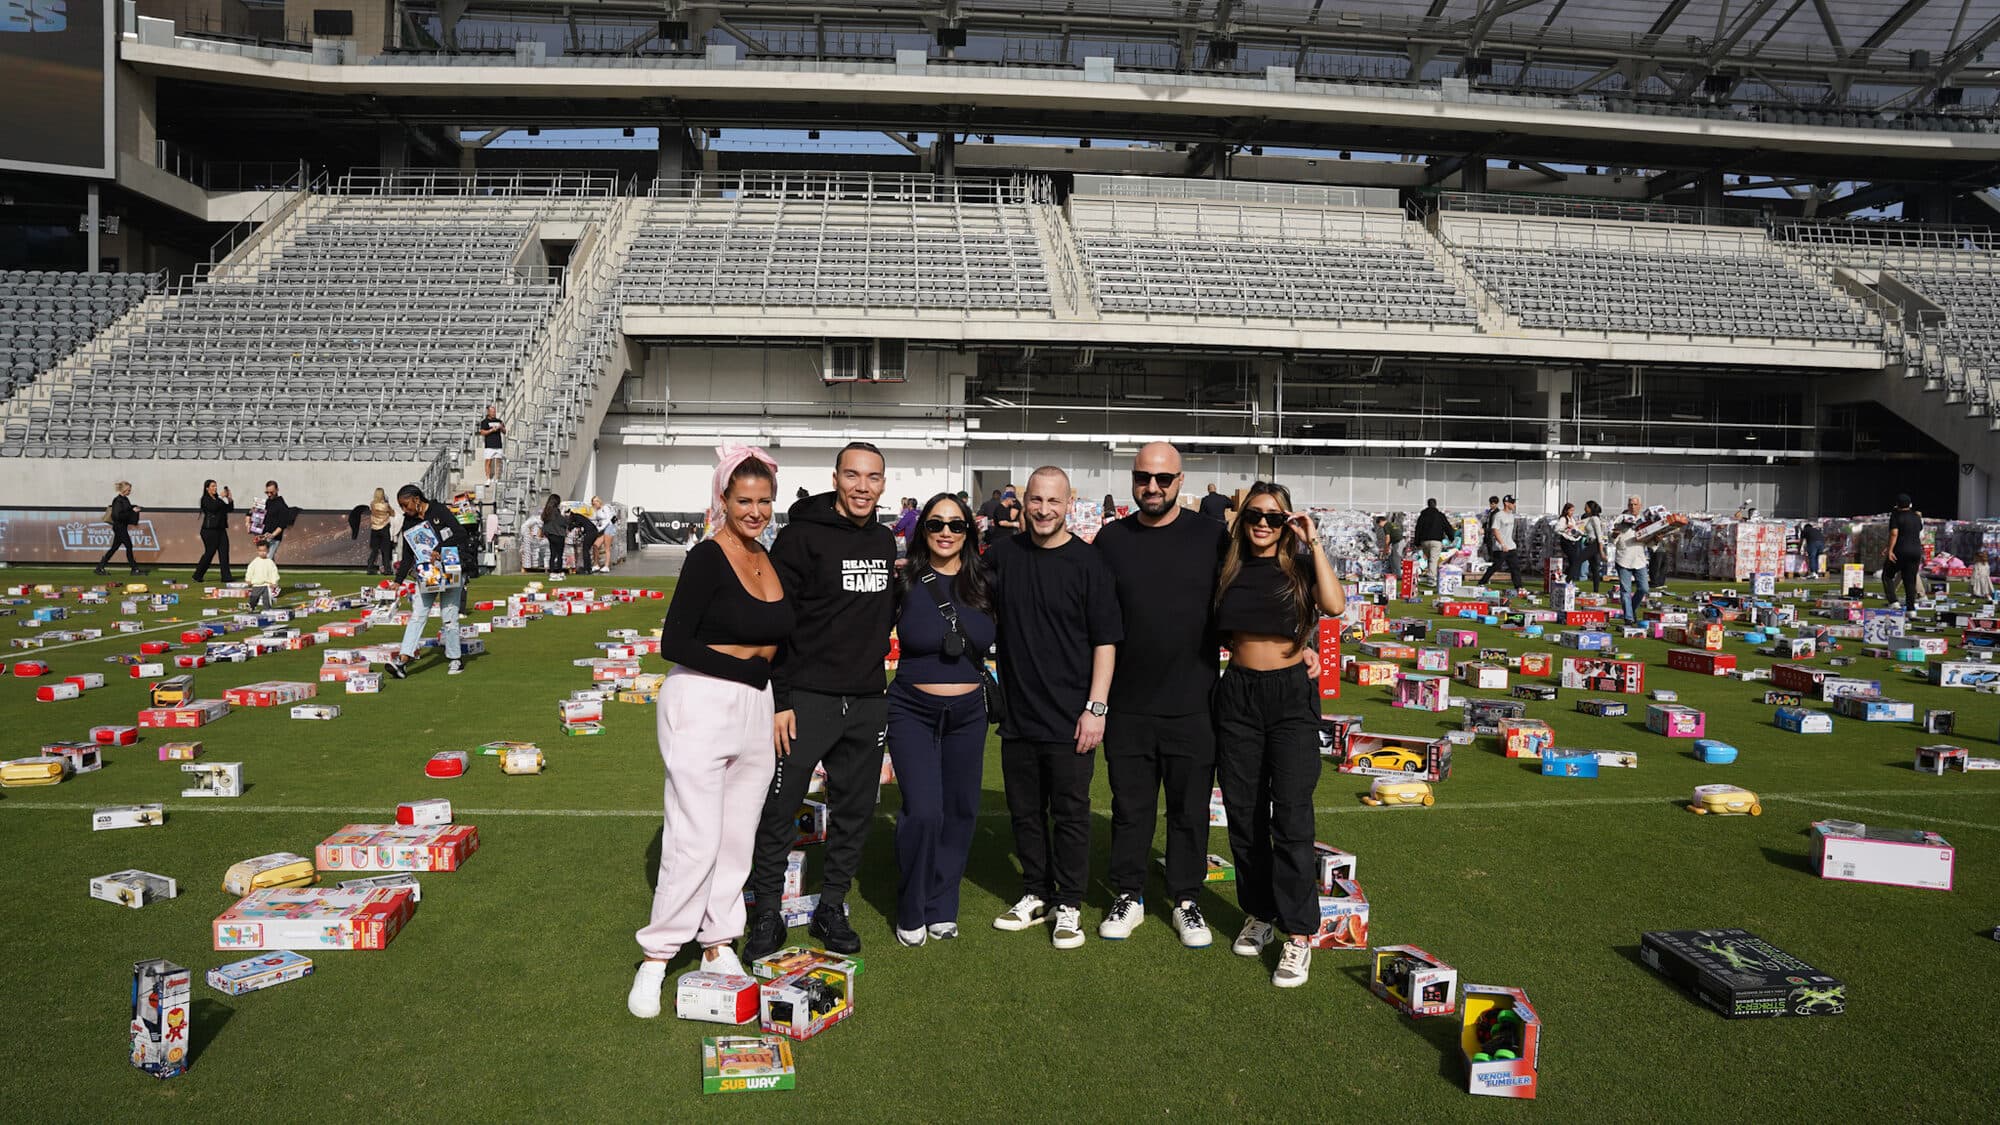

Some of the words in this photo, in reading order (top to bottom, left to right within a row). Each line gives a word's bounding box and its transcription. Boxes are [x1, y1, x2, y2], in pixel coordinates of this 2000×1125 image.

[842, 560, 887, 569] REALITY
[842, 574, 888, 592] GAMES
[1735, 1001, 1786, 1011] STRIKER-X
[1476, 1071, 1512, 1081] VENOM
[719, 1076, 780, 1091] SUBWAY
[1485, 1076, 1531, 1087] TUMBLER
